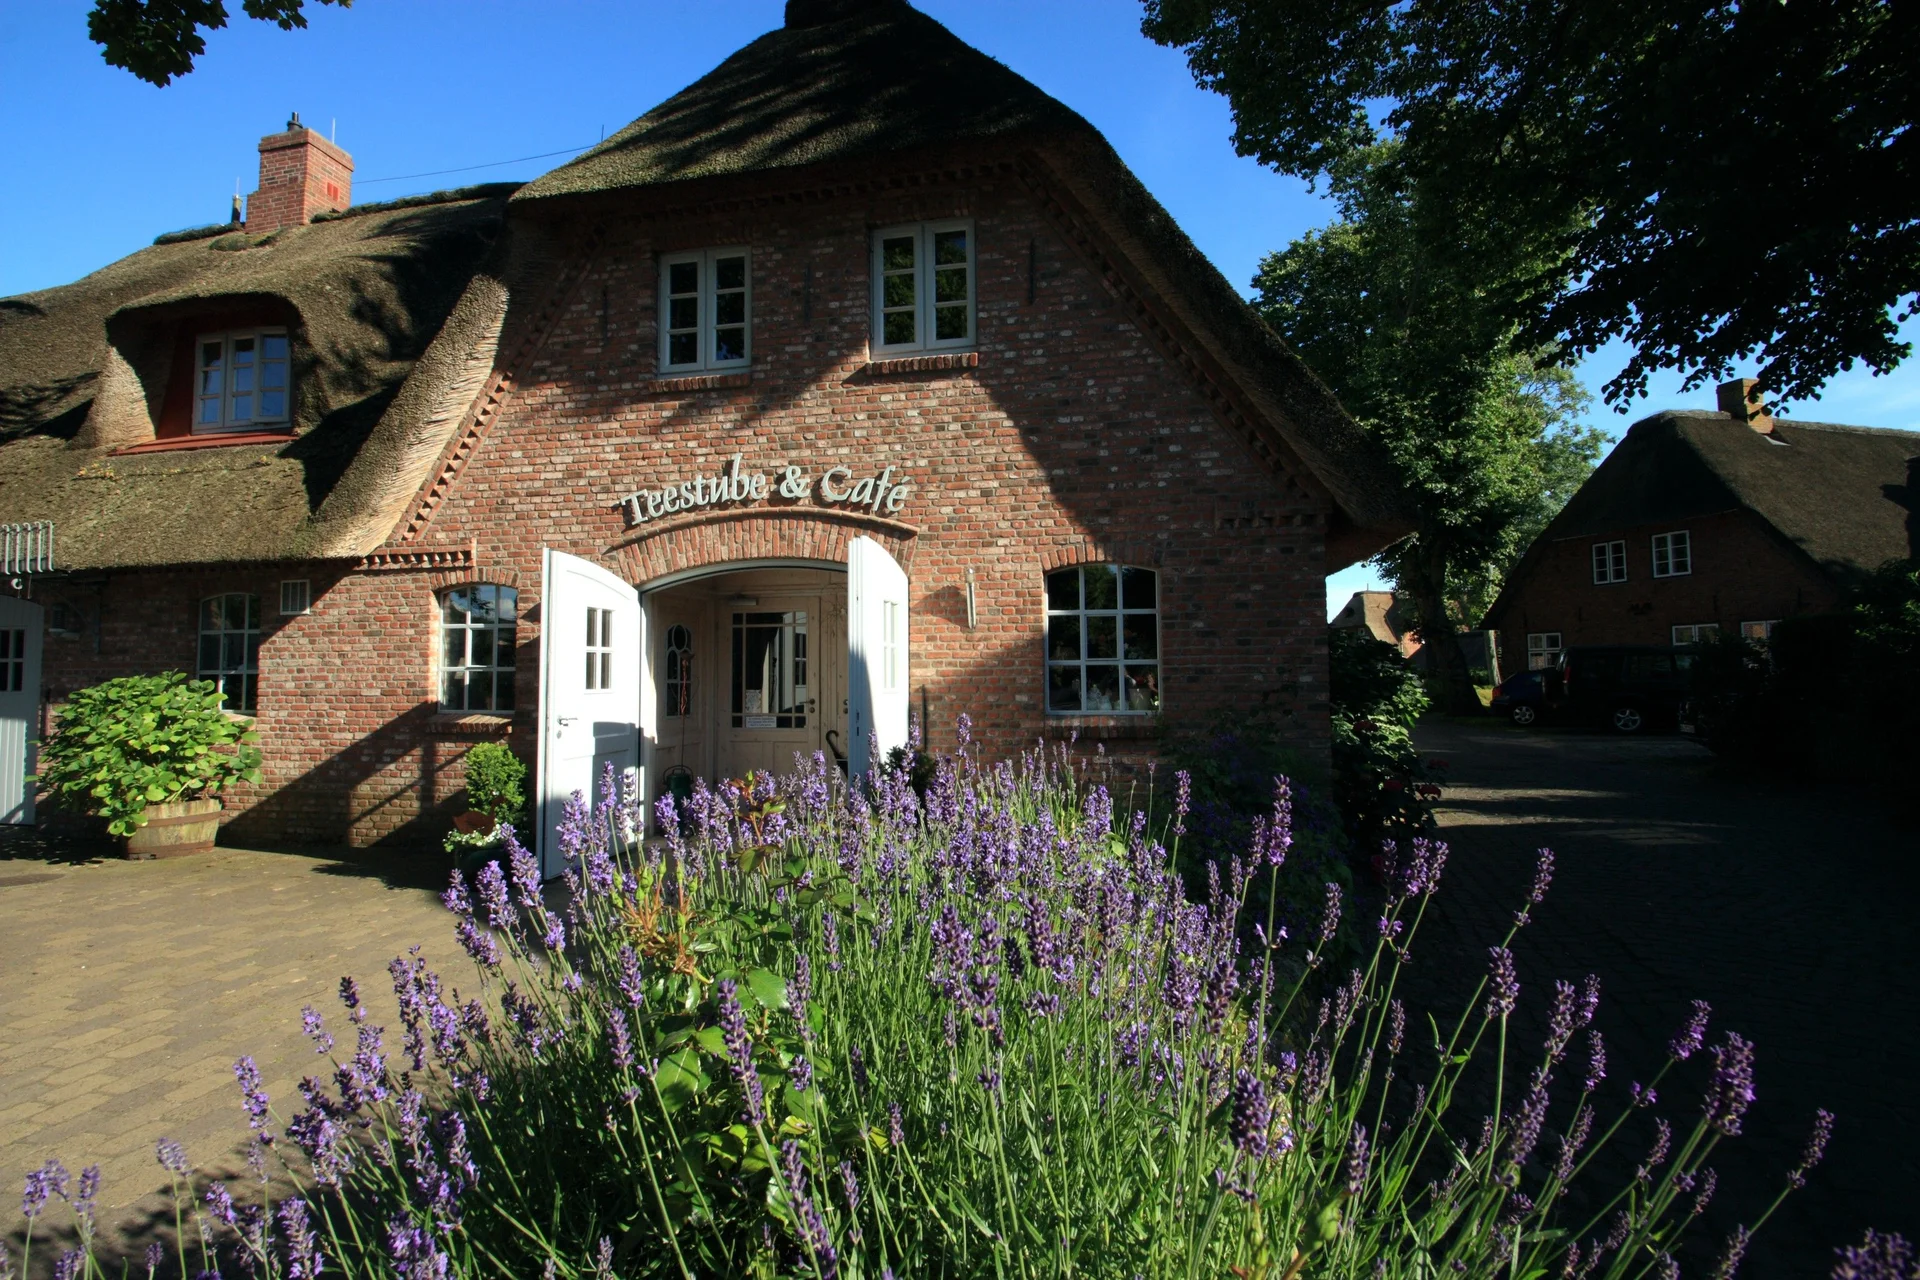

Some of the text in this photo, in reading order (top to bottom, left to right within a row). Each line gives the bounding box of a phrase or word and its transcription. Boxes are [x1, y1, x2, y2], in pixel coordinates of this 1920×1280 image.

[621, 452, 911, 526] Teestube & Café
